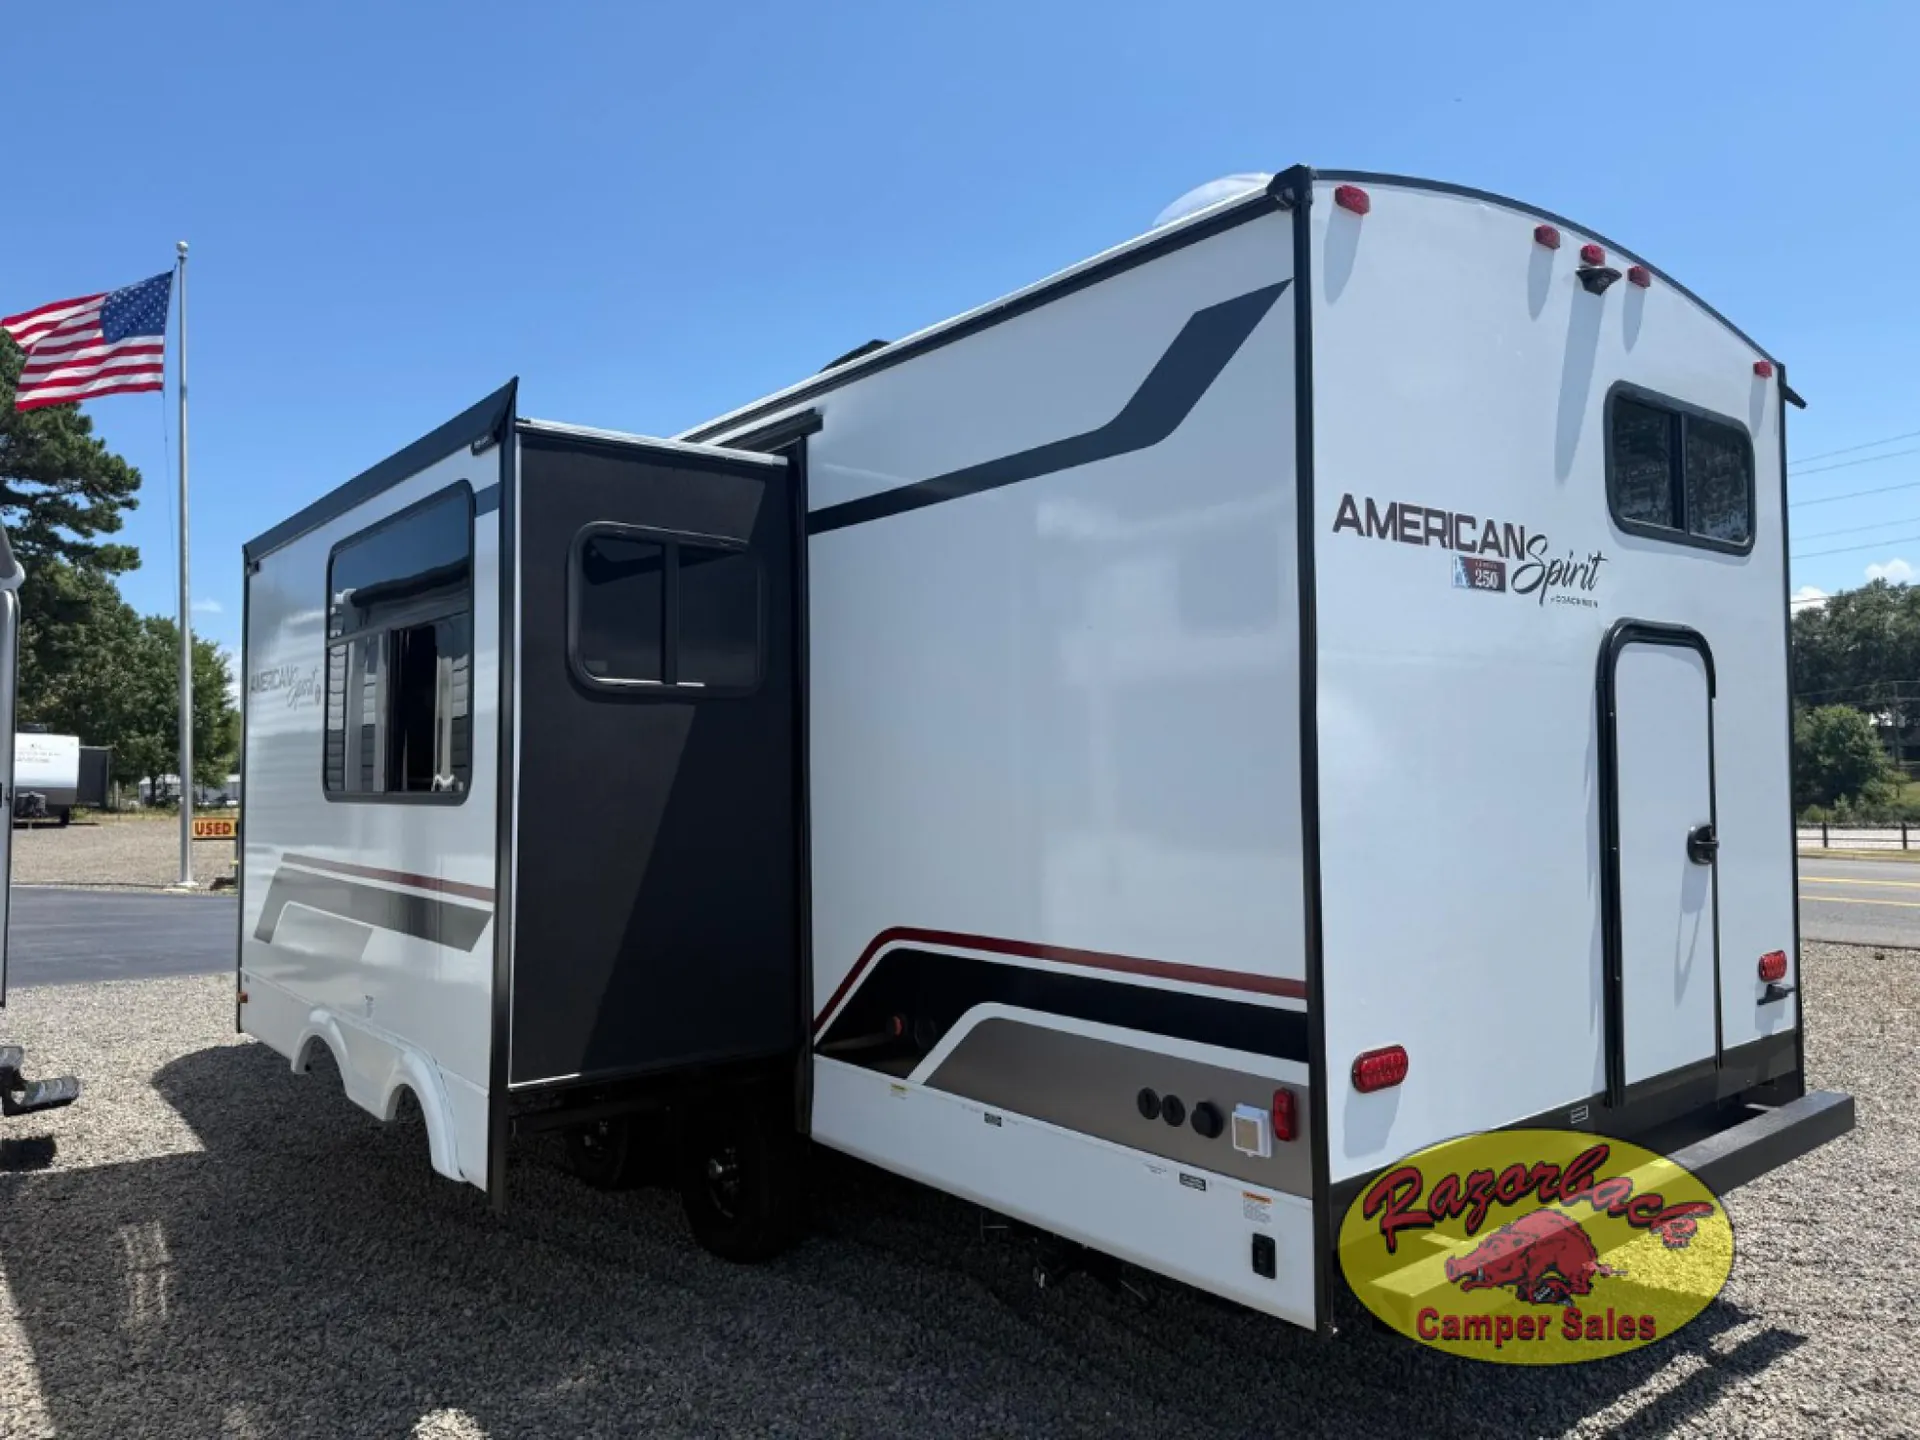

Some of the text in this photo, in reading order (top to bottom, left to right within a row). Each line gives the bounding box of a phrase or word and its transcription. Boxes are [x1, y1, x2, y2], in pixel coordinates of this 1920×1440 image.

[1332, 493, 1608, 606] AMERICAN Spirit
[194, 821, 232, 836] USED
